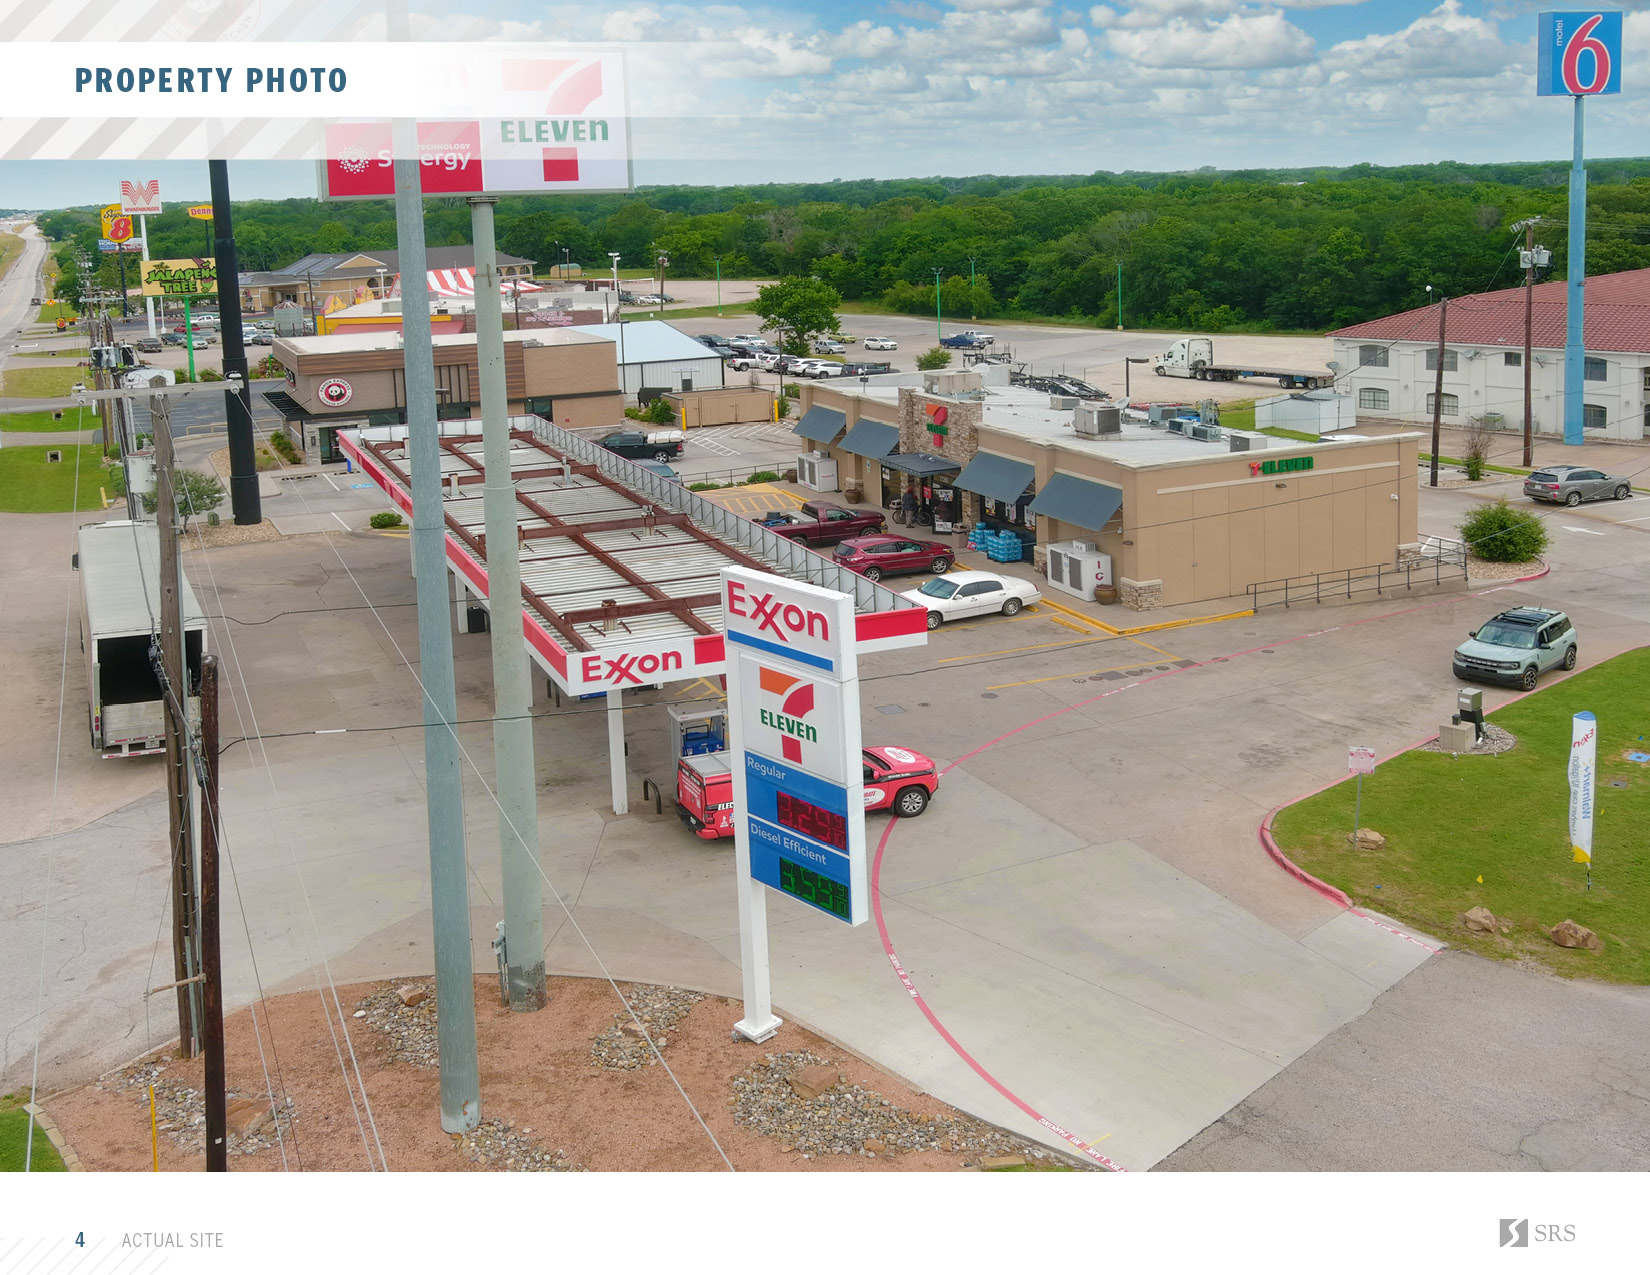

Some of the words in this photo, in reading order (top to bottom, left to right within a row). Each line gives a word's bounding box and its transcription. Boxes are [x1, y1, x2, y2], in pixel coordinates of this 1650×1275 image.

[1555, 20, 1564, 46] motel
[1561, 14, 1611, 94] 6
[416, 143, 471, 151] TECHNOLOGY
[378, 150, 471, 171] Sergy
[109, 218, 132, 240] 8
[161, 281, 197, 293] TREE
[727, 579, 830, 642] Exxon
[582, 650, 682, 685] Exxon
[759, 666, 815, 764] 7
[747, 756, 786, 781] Regular
[779, 791, 831, 842] 3.29
[751, 823, 781, 845] Diesel
[783, 837, 827, 866] Efficient
[782, 857, 833, 910] 3.59
[1039, 1117, 1069, 1139] PARKING
[1069, 1136, 1082, 1146] NO
[1086, 1147, 1107, 1162] LANE
[1106, 1160, 1127, 1172] FIRE
